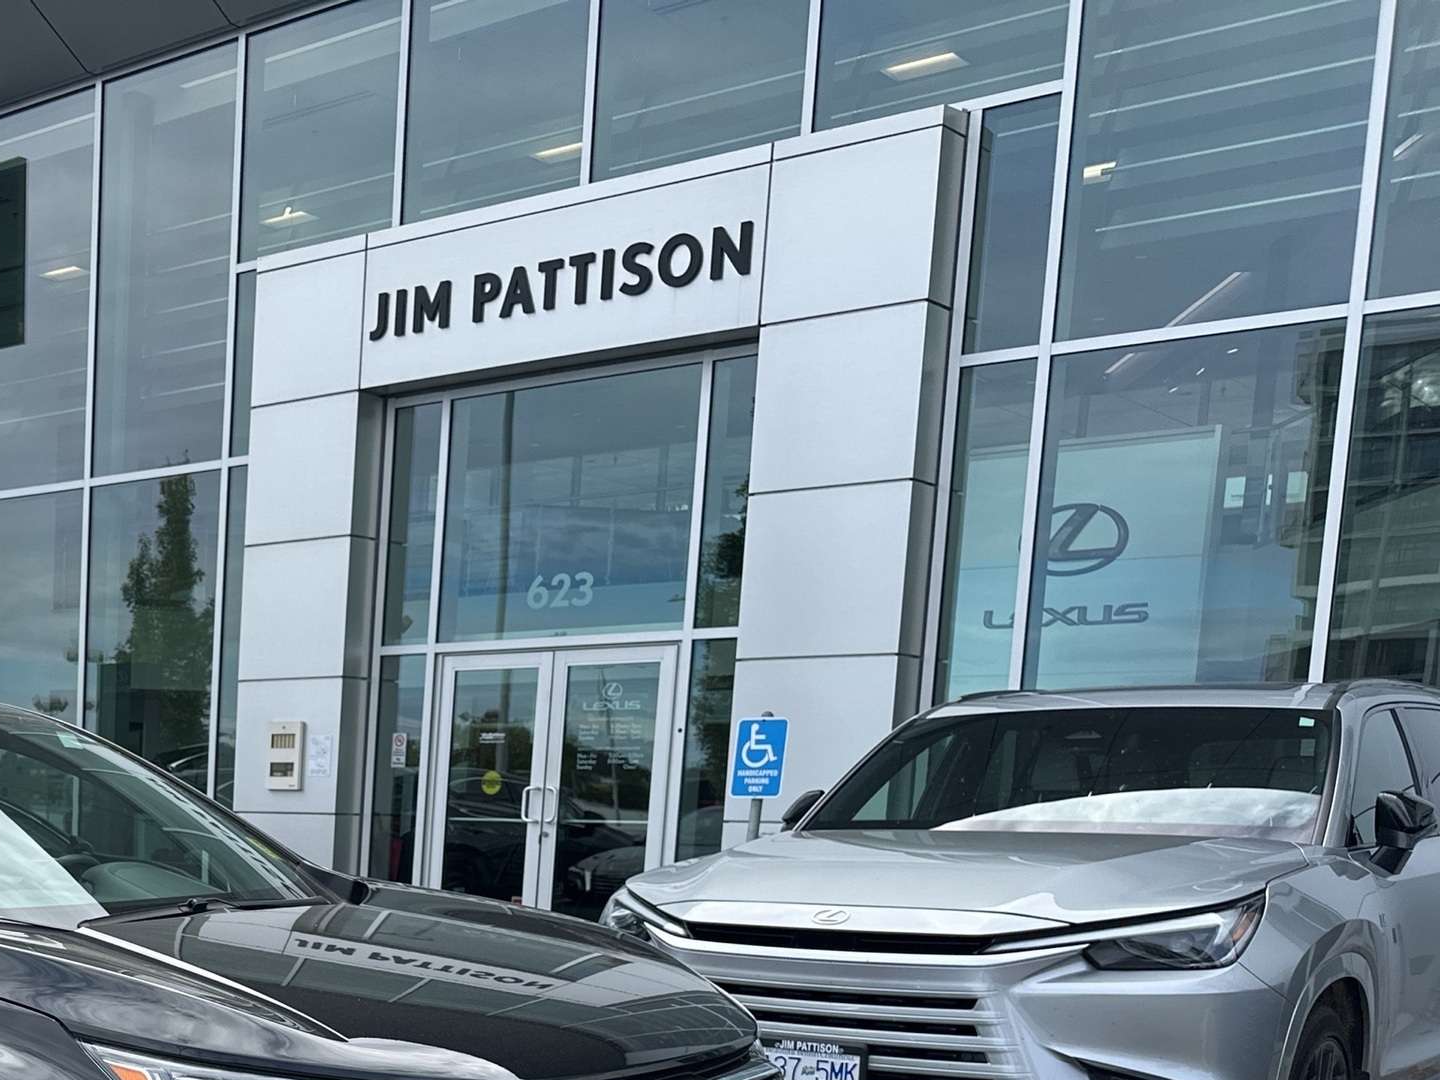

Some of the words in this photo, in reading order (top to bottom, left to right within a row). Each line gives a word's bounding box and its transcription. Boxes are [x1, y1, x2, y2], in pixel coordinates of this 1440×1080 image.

[369, 281, 451, 342] JIM
[473, 221, 755, 324] PATTISON
[527, 571, 594, 609] 623
[983, 602, 1150, 629] LXUS
[582, 700, 641, 711] LEXUS
[737, 769, 779, 777] HANDICAPPED
[744, 777, 770, 785] PARKING
[748, 785, 763, 793] ONLY
[780, 1039, 795, 1050] JIM
[796, 1041, 840, 1054] PATTISON
